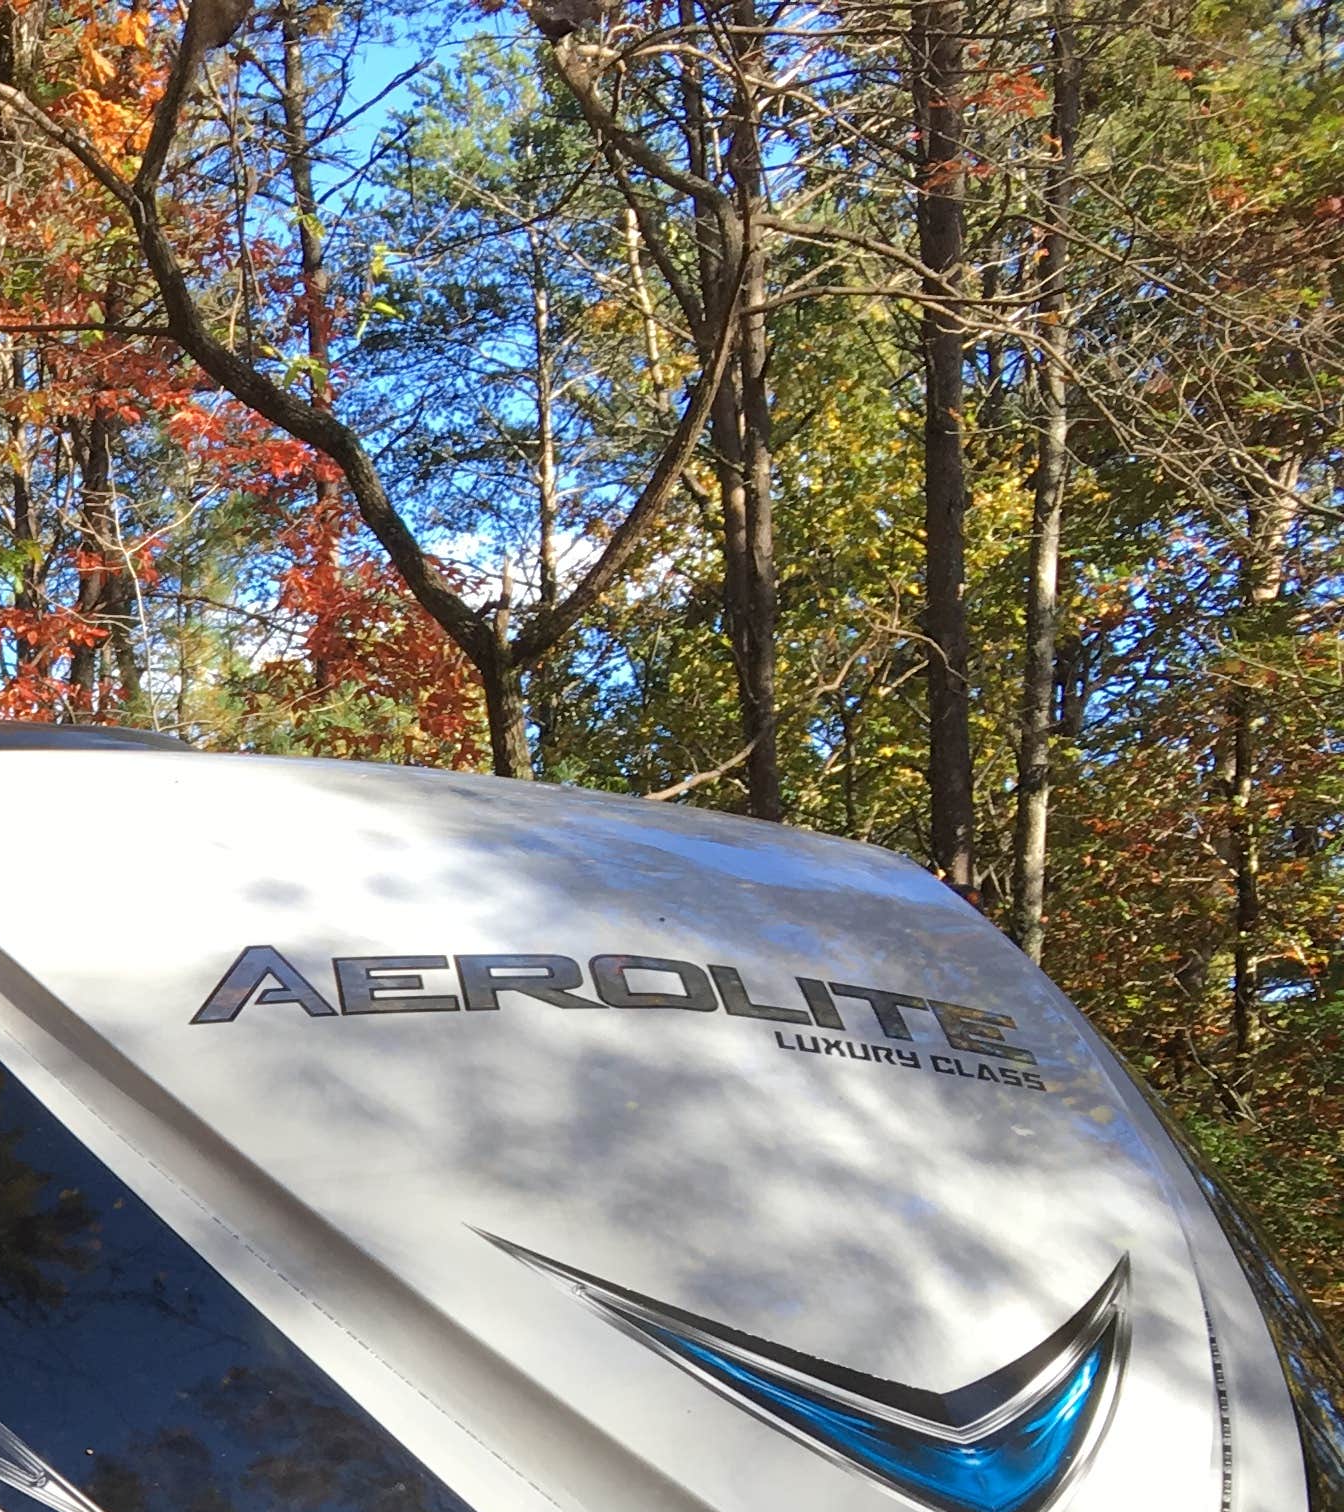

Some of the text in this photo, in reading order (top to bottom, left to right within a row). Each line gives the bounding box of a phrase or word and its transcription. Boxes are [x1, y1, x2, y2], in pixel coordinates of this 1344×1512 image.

[189, 945, 1038, 1066] AEROLITE
[774, 1031, 1047, 1092] LUXURY CLASS
